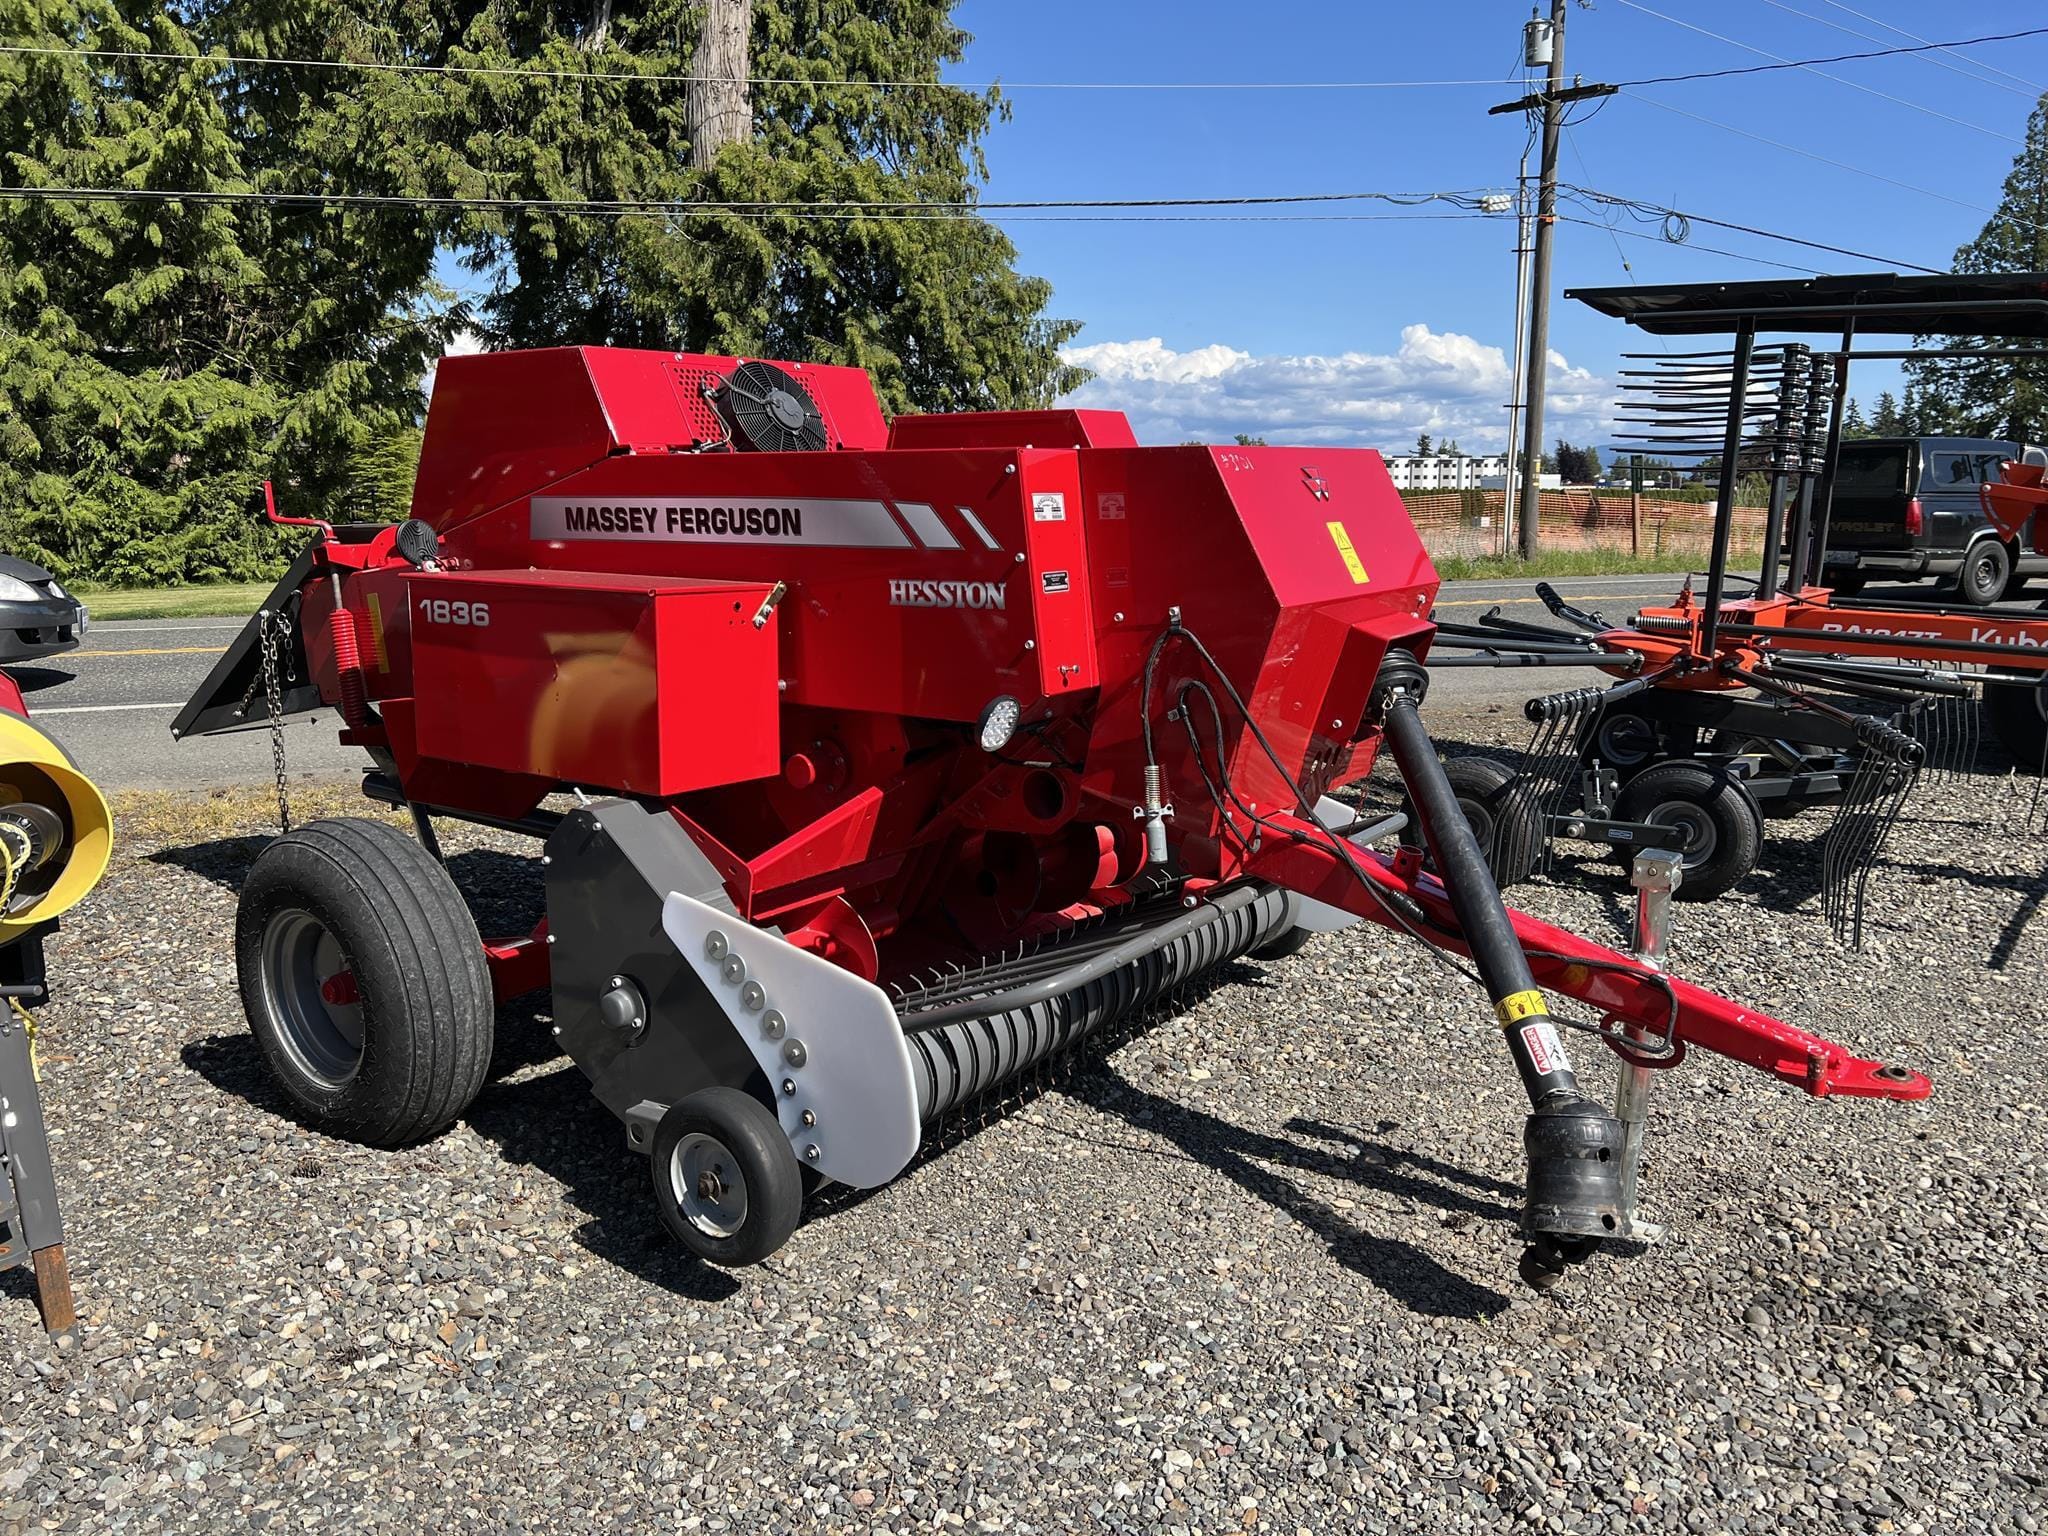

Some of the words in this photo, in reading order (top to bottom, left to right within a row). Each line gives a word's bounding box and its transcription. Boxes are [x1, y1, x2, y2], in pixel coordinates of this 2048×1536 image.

[565, 507, 658, 533] MASSEY
[666, 507, 802, 536] FERGUSON
[889, 579, 1006, 610] HESSTON
[419, 599, 490, 626] 1836
[1526, 1028, 1547, 1061] DANGER
